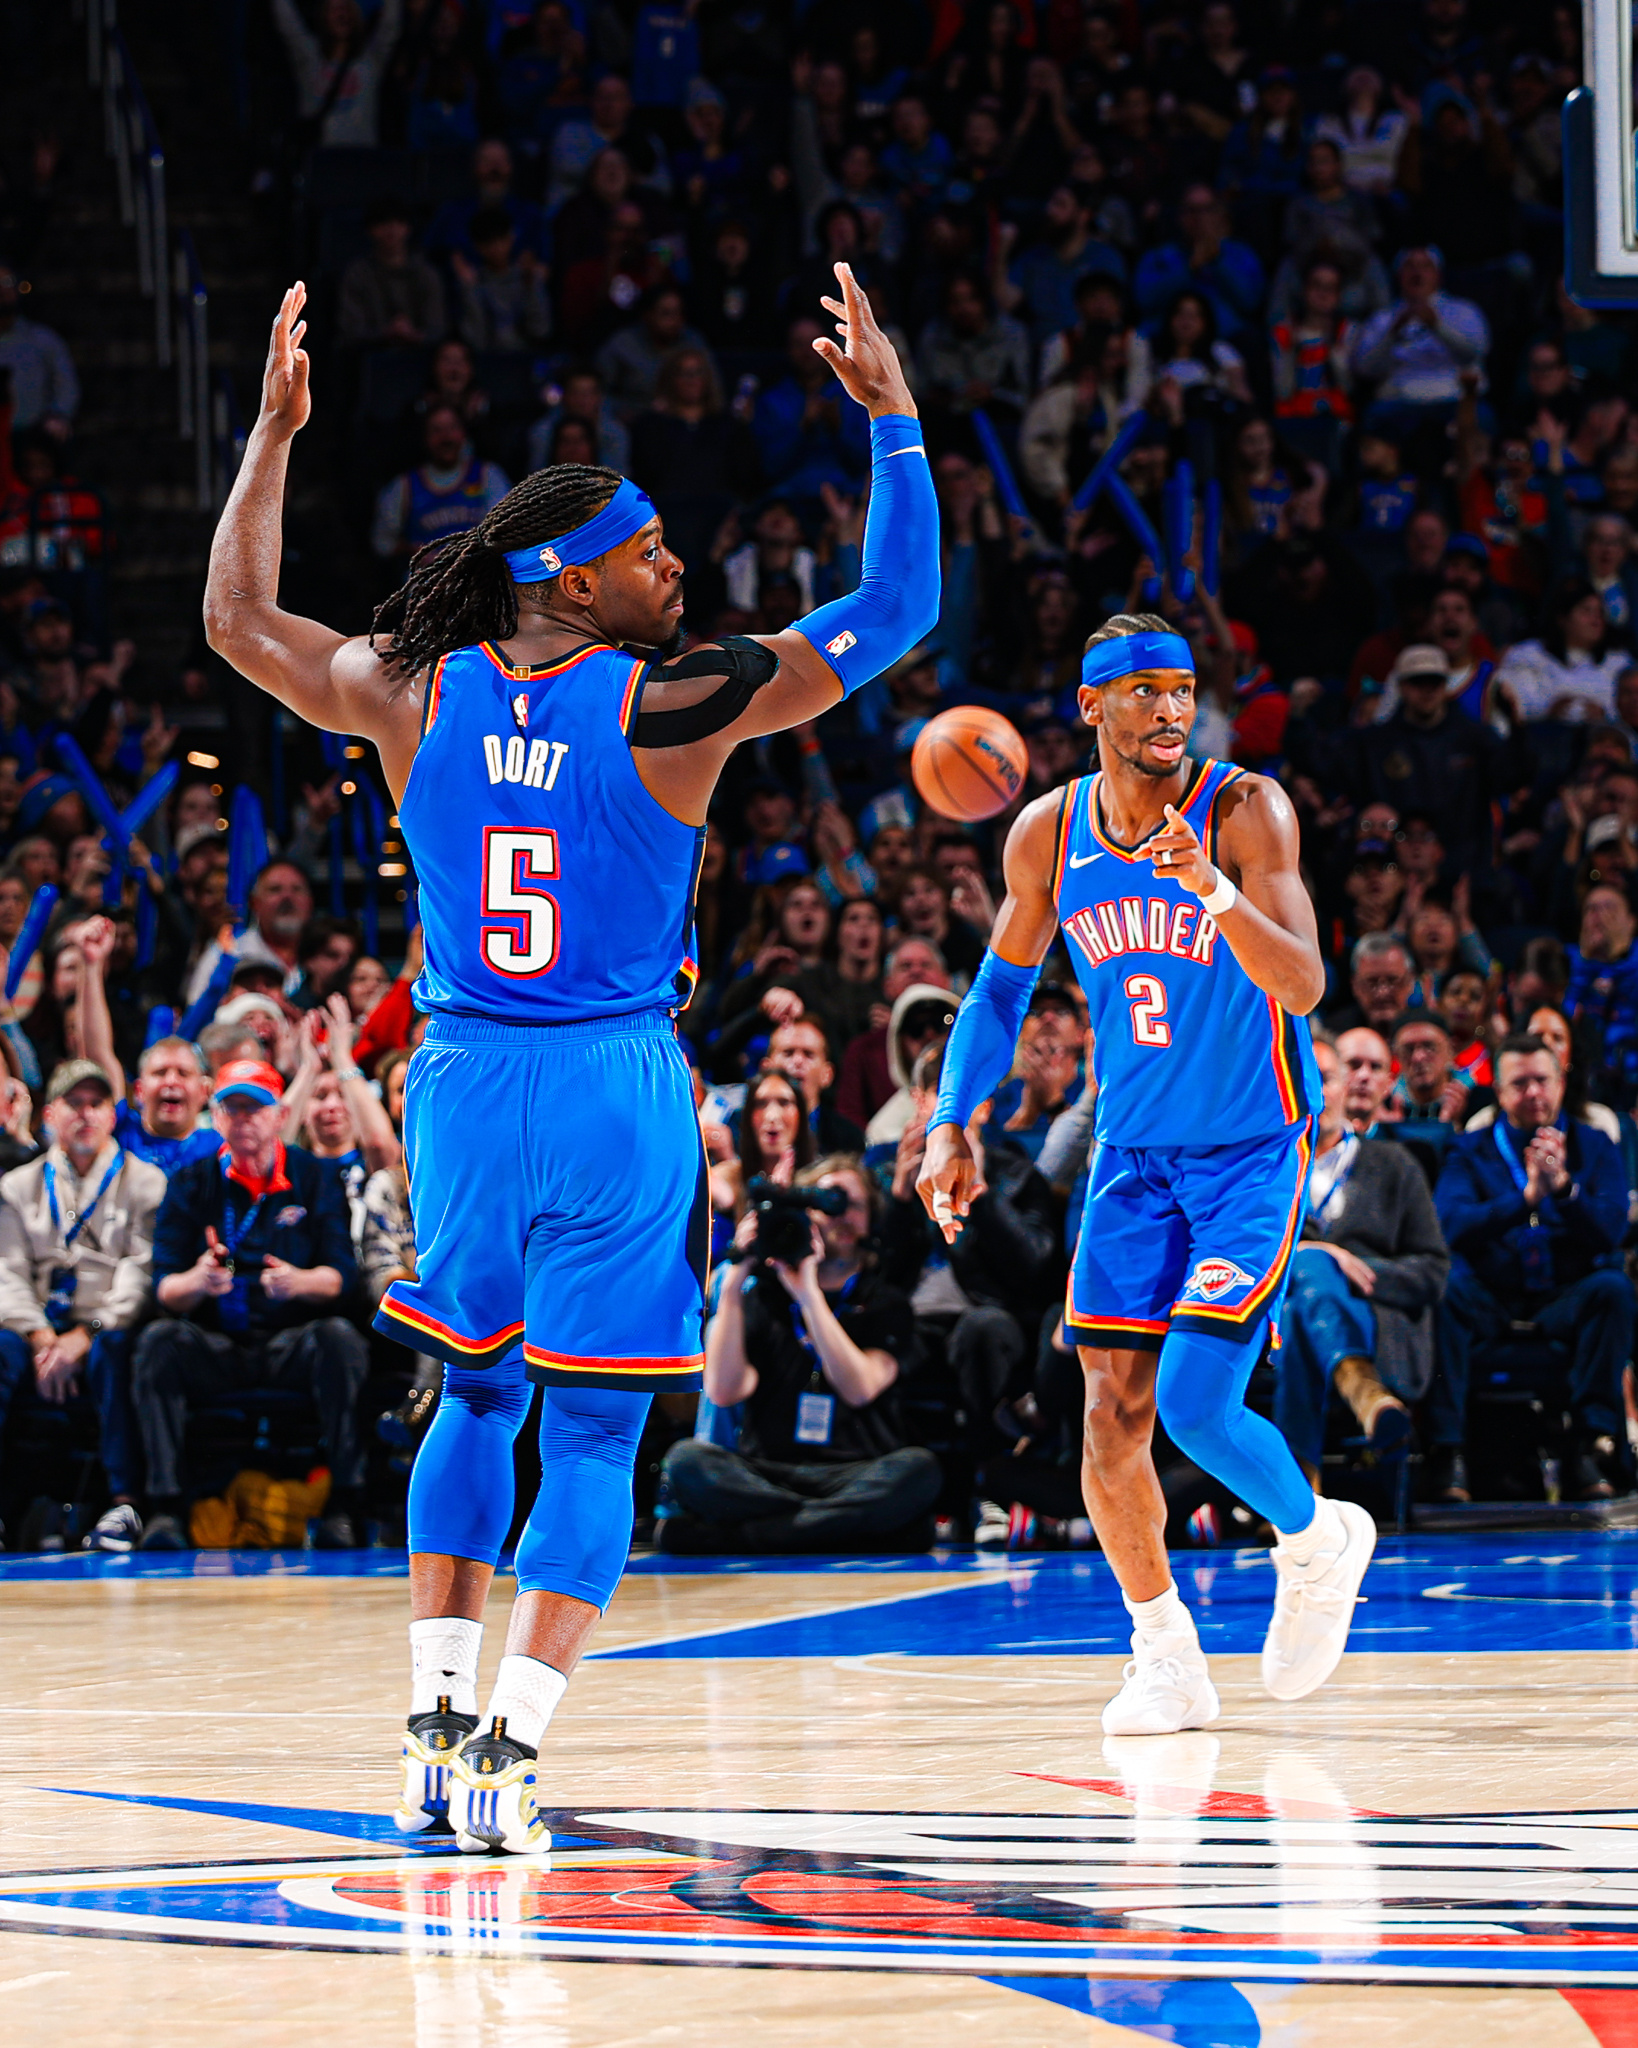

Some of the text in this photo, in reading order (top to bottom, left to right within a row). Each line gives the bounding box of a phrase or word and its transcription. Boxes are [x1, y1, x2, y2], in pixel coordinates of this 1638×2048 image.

[483, 734, 570, 792] DORT
[479, 825, 561, 980] 5
[1061, 896, 1219, 969] THUNDER
[1123, 973, 1172, 1048] 2
[1191, 1268, 1231, 1289] OKC
